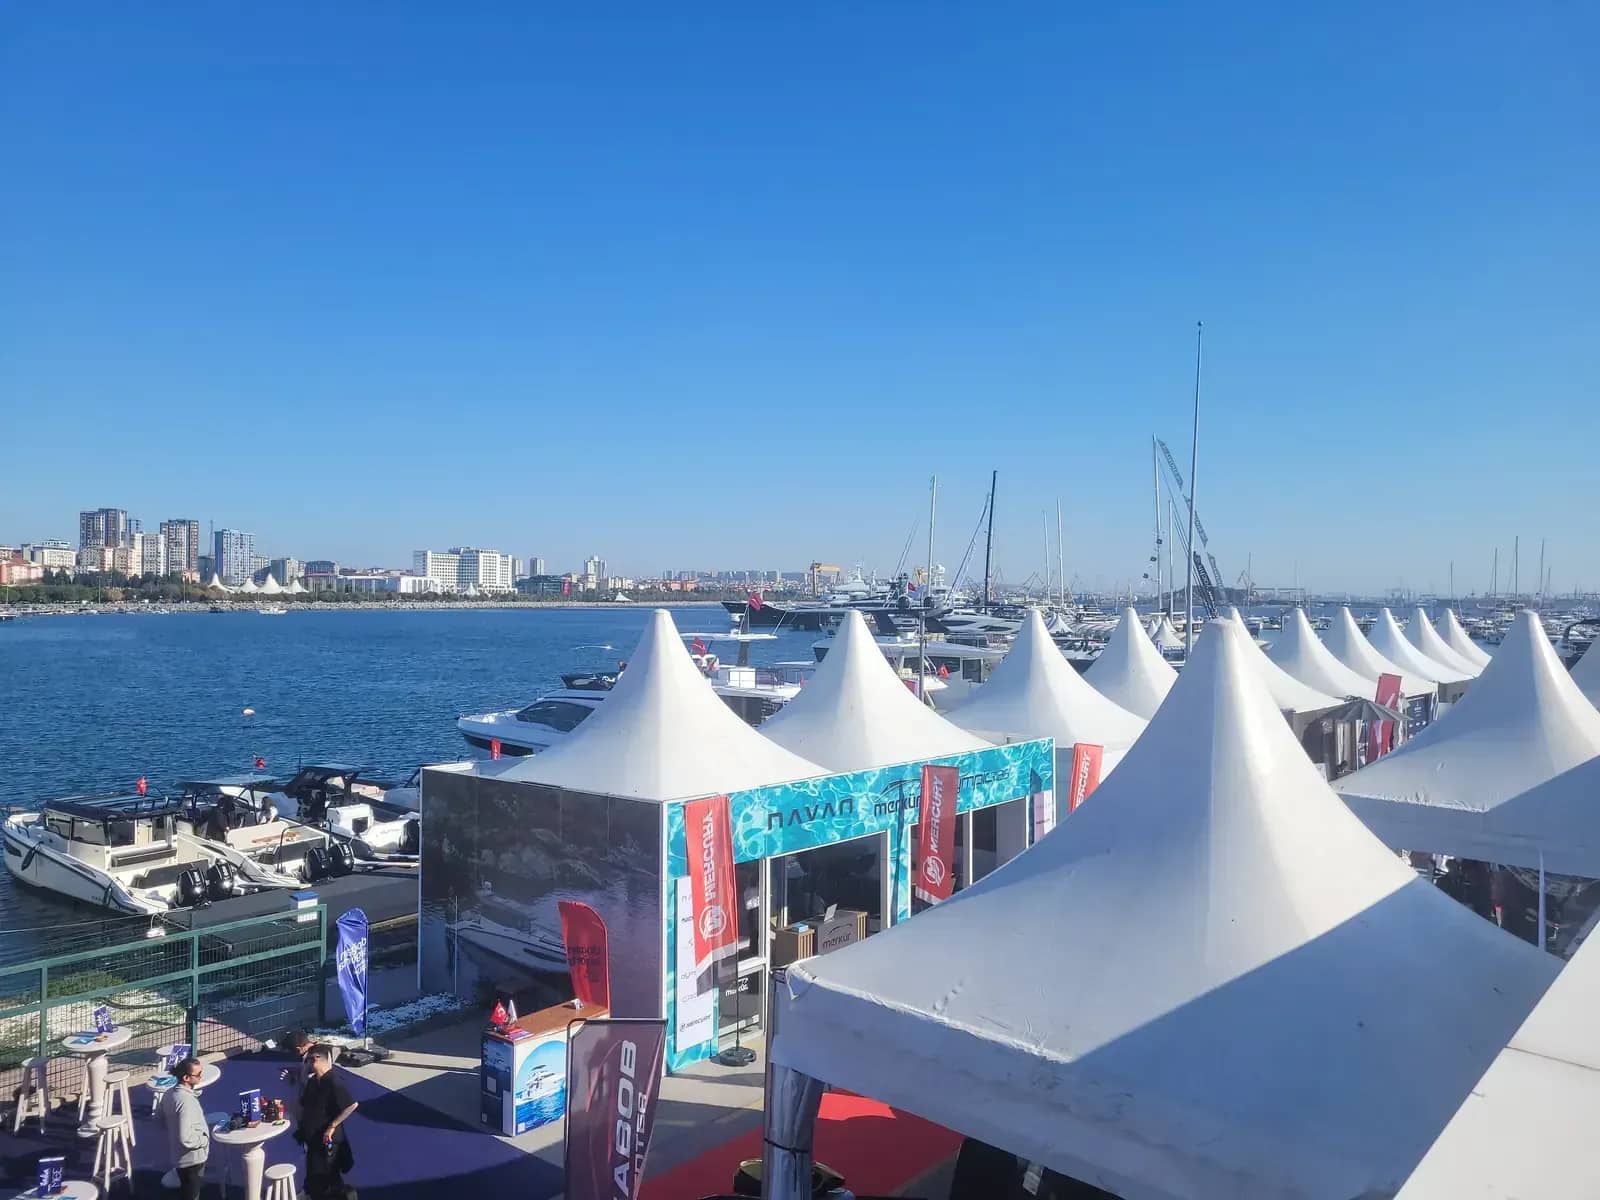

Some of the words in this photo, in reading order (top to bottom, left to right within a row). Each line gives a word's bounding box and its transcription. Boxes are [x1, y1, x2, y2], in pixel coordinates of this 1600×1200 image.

[930, 775, 944, 854] MERCURY
[1076, 751, 1091, 808] ERCURY
[613, 1039, 637, 1200] ABOB
